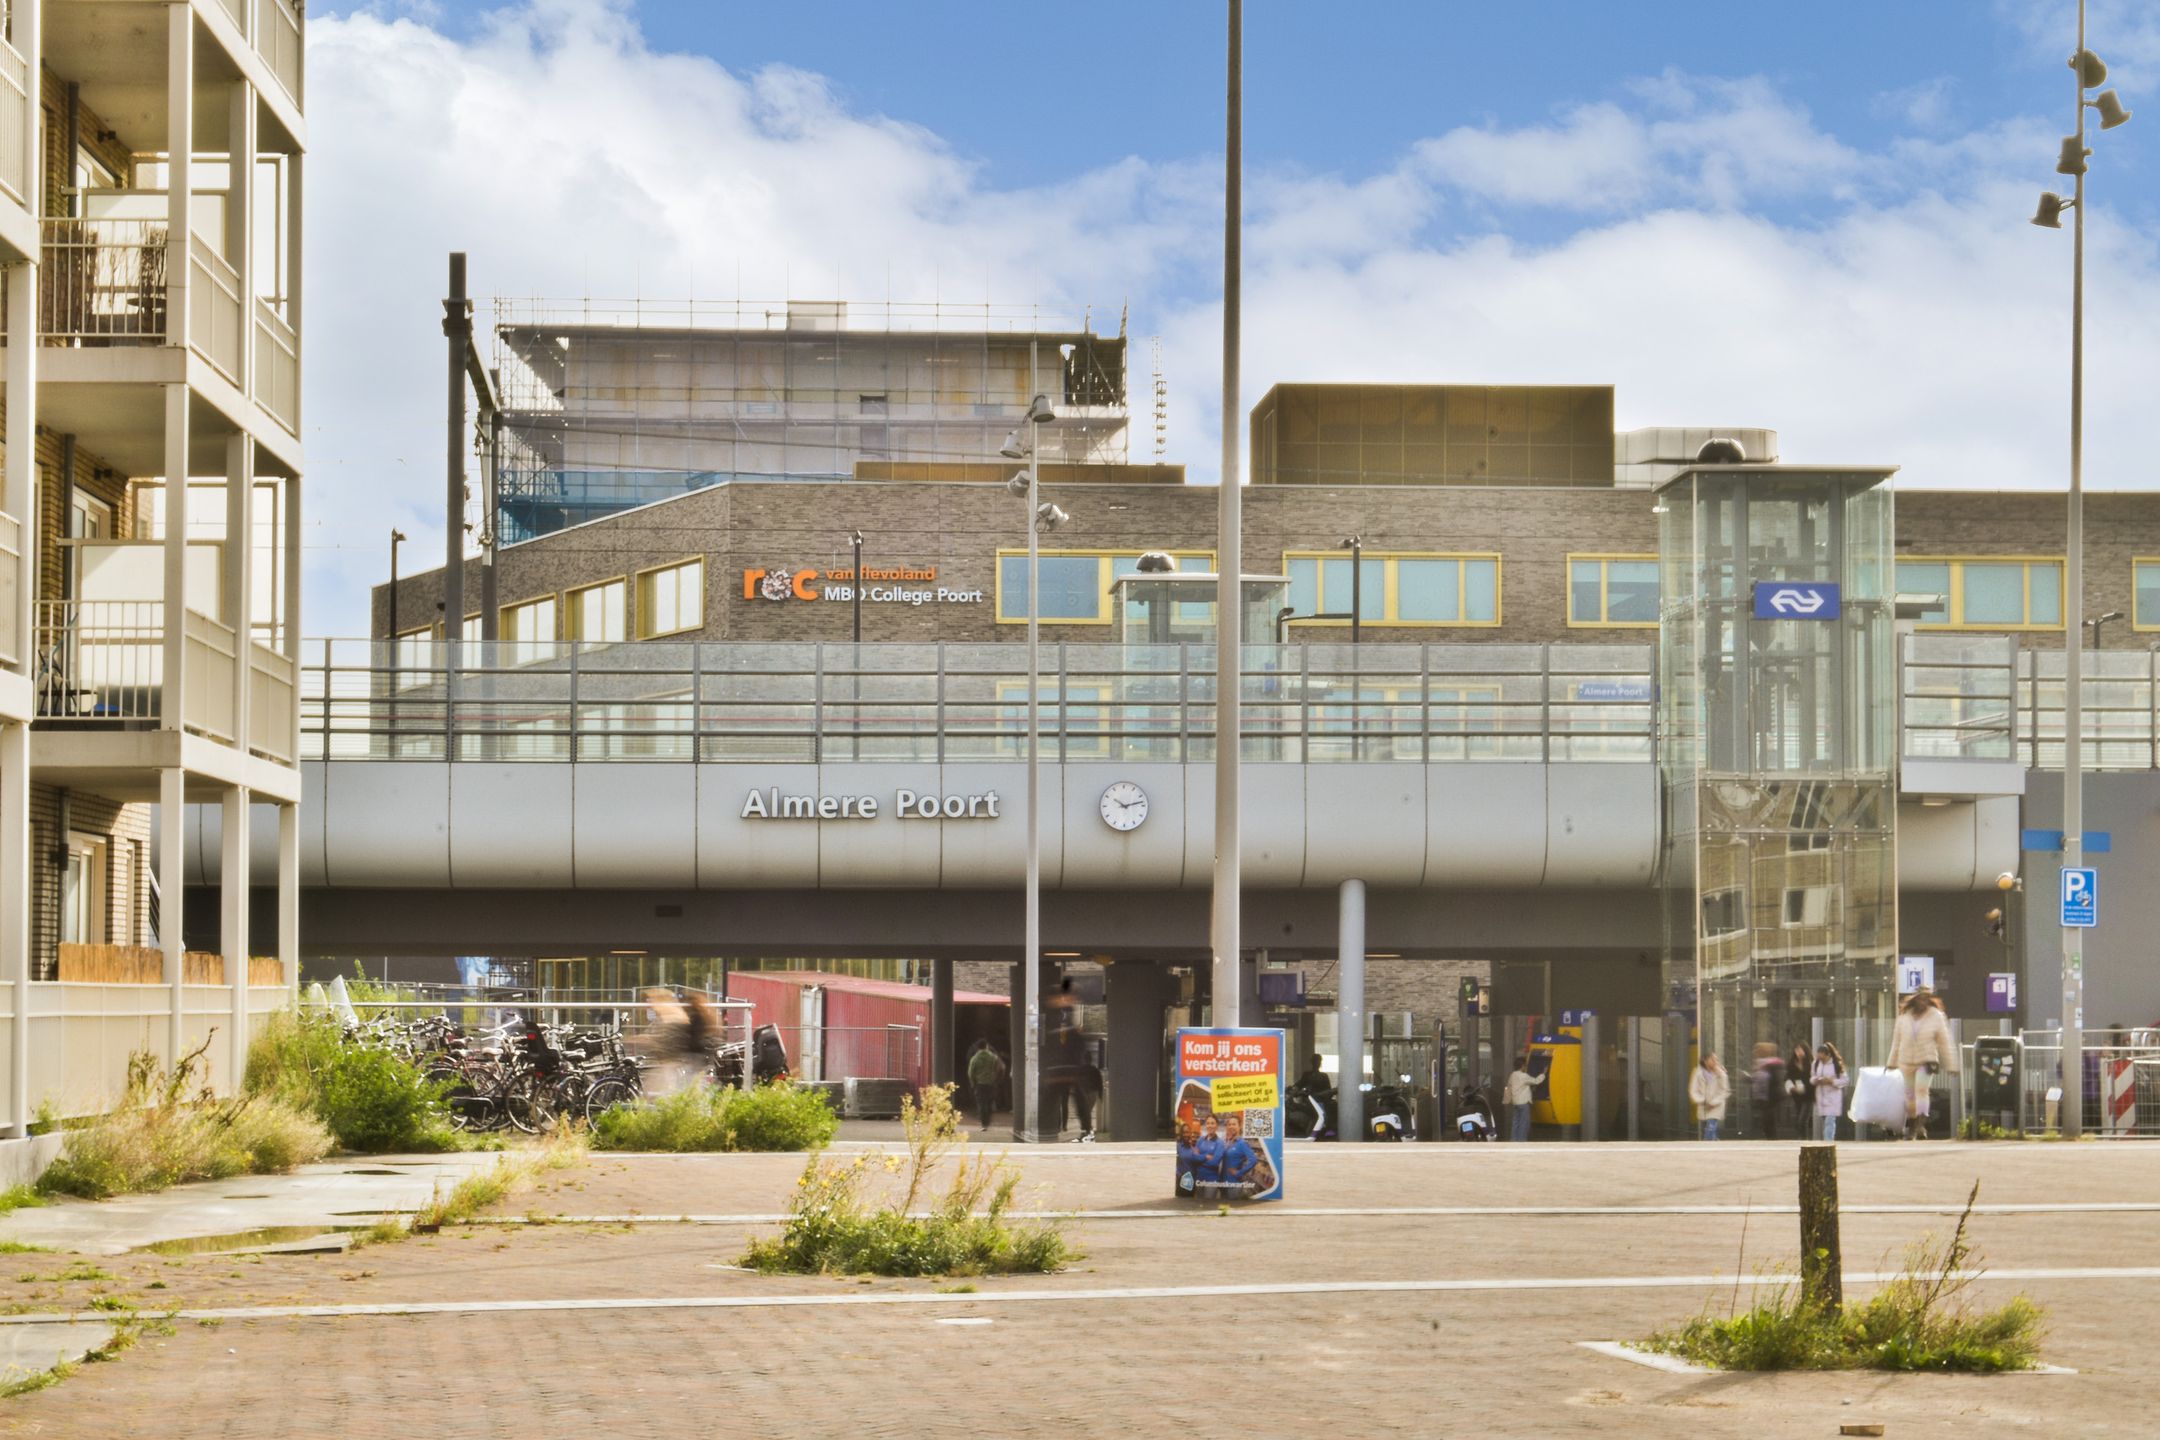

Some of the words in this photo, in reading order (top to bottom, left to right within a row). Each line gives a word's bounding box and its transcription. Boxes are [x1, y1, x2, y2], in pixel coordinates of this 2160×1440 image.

[870, 587, 932, 605] College
[938, 587, 983, 602] Poort
[1584, 688, 1616, 696] Almere
[1619, 688, 1642, 696] Poort
[740, 787, 878, 819] Almere
[896, 789, 1000, 819] Poort
[2066, 872, 2086, 902] P
[1185, 1041, 1214, 1054] Kom
[1217, 1041, 1230, 1058] jij
[1234, 1044, 1262, 1056] ons
[1185, 1058, 1268, 1072] versterken?
